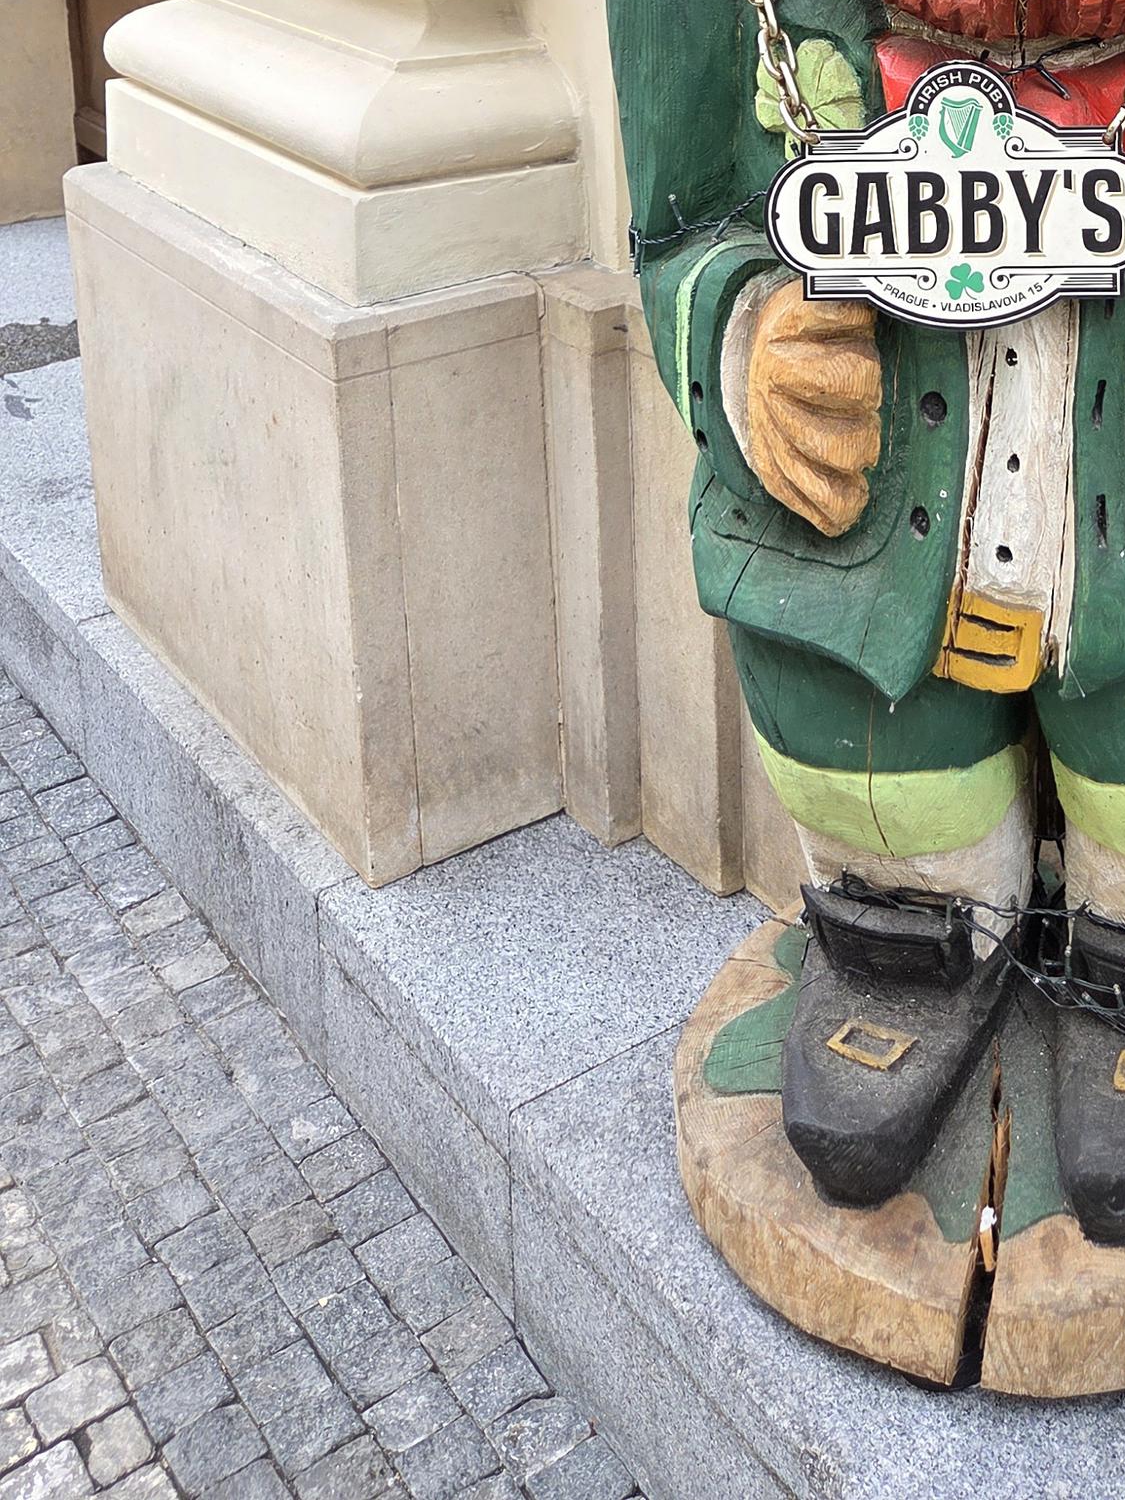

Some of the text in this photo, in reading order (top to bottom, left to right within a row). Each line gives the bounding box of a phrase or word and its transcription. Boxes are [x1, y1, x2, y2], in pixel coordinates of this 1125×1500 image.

[918, 70, 1005, 104] IRISH PUB
[799, 168, 1125, 258] GABBY'S
[882, 282, 1044, 313] PRAGUE VLADISLAVOVA 15
